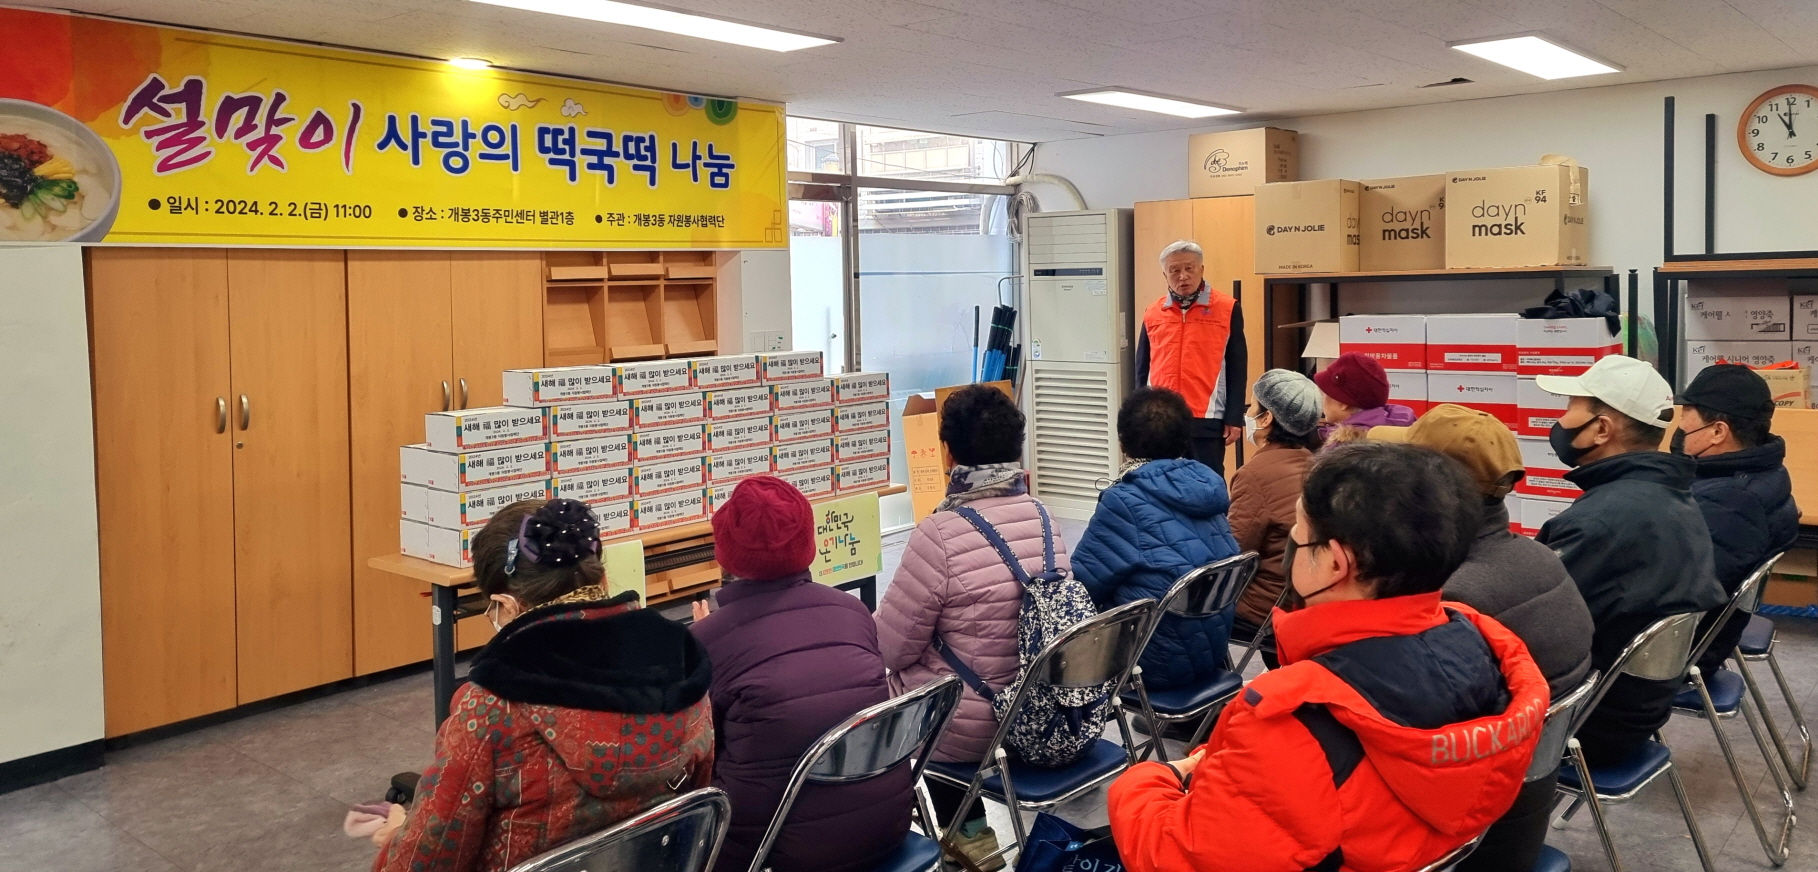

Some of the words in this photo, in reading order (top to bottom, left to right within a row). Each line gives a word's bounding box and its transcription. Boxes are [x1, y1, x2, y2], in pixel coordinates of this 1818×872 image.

[1769, 103, 1779, 112] 11
[1785, 96, 1797, 106] 12
[1805, 100, 1810, 108] 1
[1756, 115, 1768, 124] 10
[121, 75, 362, 173] 설맞이
[376, 114, 519, 174] 사랑의
[537, 125, 657, 187] 떡국떡
[671, 140, 736, 189] 나눔
[1751, 129, 1760, 137] 9
[1757, 142, 1765, 151] 8
[1771, 152, 1778, 161] 7
[1786, 155, 1794, 164] 6
[1804, 150, 1812, 159] 5
[1535, 196, 1547, 204] 94
[166, 196, 198, 215] 일시
[214, 199, 264, 216] 2024.
[333, 204, 372, 219] 11:00
[1472, 199, 1526, 221] dayn
[412, 206, 437, 222] 장소
[448, 206, 536, 225] 개봉3동주민센터
[539, 210, 574, 226] 별관1층
[606, 212, 625, 227] 주관
[633, 212, 666, 228] 개봉3동
[667, 214, 725, 228] 자원봉사협력단
[1382, 206, 1431, 226] dayn
[1382, 222, 1431, 241] mask
[1472, 216, 1526, 236] mask
[1750, 310, 1774, 319] 영양죽
[1752, 355, 1775, 364] 영양죽
[624, 372, 637, 380] 새해
[648, 370, 661, 378] 많이
[663, 368, 687, 377] 받으세요
[540, 379, 556, 387] 새해
[568, 377, 582, 386] 많이
[584, 376, 612, 385] 받으세요
[747, 394, 769, 402] 받으세요
[640, 404, 654, 412] 새해
[664, 402, 676, 410] 많이
[678, 399, 702, 408] 받으세요
[559, 412, 574, 420] 새해
[586, 410, 599, 418] 많이
[602, 408, 628, 417] 받으세요
[464, 422, 480, 431] 새해
[494, 419, 508, 428] 많이
[511, 416, 541, 426] 받으세요
[638, 438, 652, 446] 새해
[677, 433, 701, 442] 받으세요
[559, 449, 573, 458] 새해
[585, 446, 598, 455] 많이
[601, 443, 627, 453] 받으세요
[467, 459, 484, 468] 새해
[497, 455, 512, 464] 많이
[515, 451, 545, 462] 받으세요
[640, 472, 653, 481] 새해
[664, 469, 676, 477] 많이
[678, 465, 701, 475] 받으세요
[560, 483, 574, 492] 새해
[586, 480, 599, 488] 많이
[602, 476, 628, 486] 받으세요
[467, 499, 484, 508] 새해
[498, 494, 512, 504] 많이
[515, 490, 545, 501] 받으세요
[640, 506, 653, 514] 새해
[664, 502, 676, 510] 많이
[678, 498, 702, 508] 받으세요
[603, 509, 629, 521] 받으세요
[817, 510, 854, 535] 대한민국
[819, 533, 860, 563] 온기나눔
